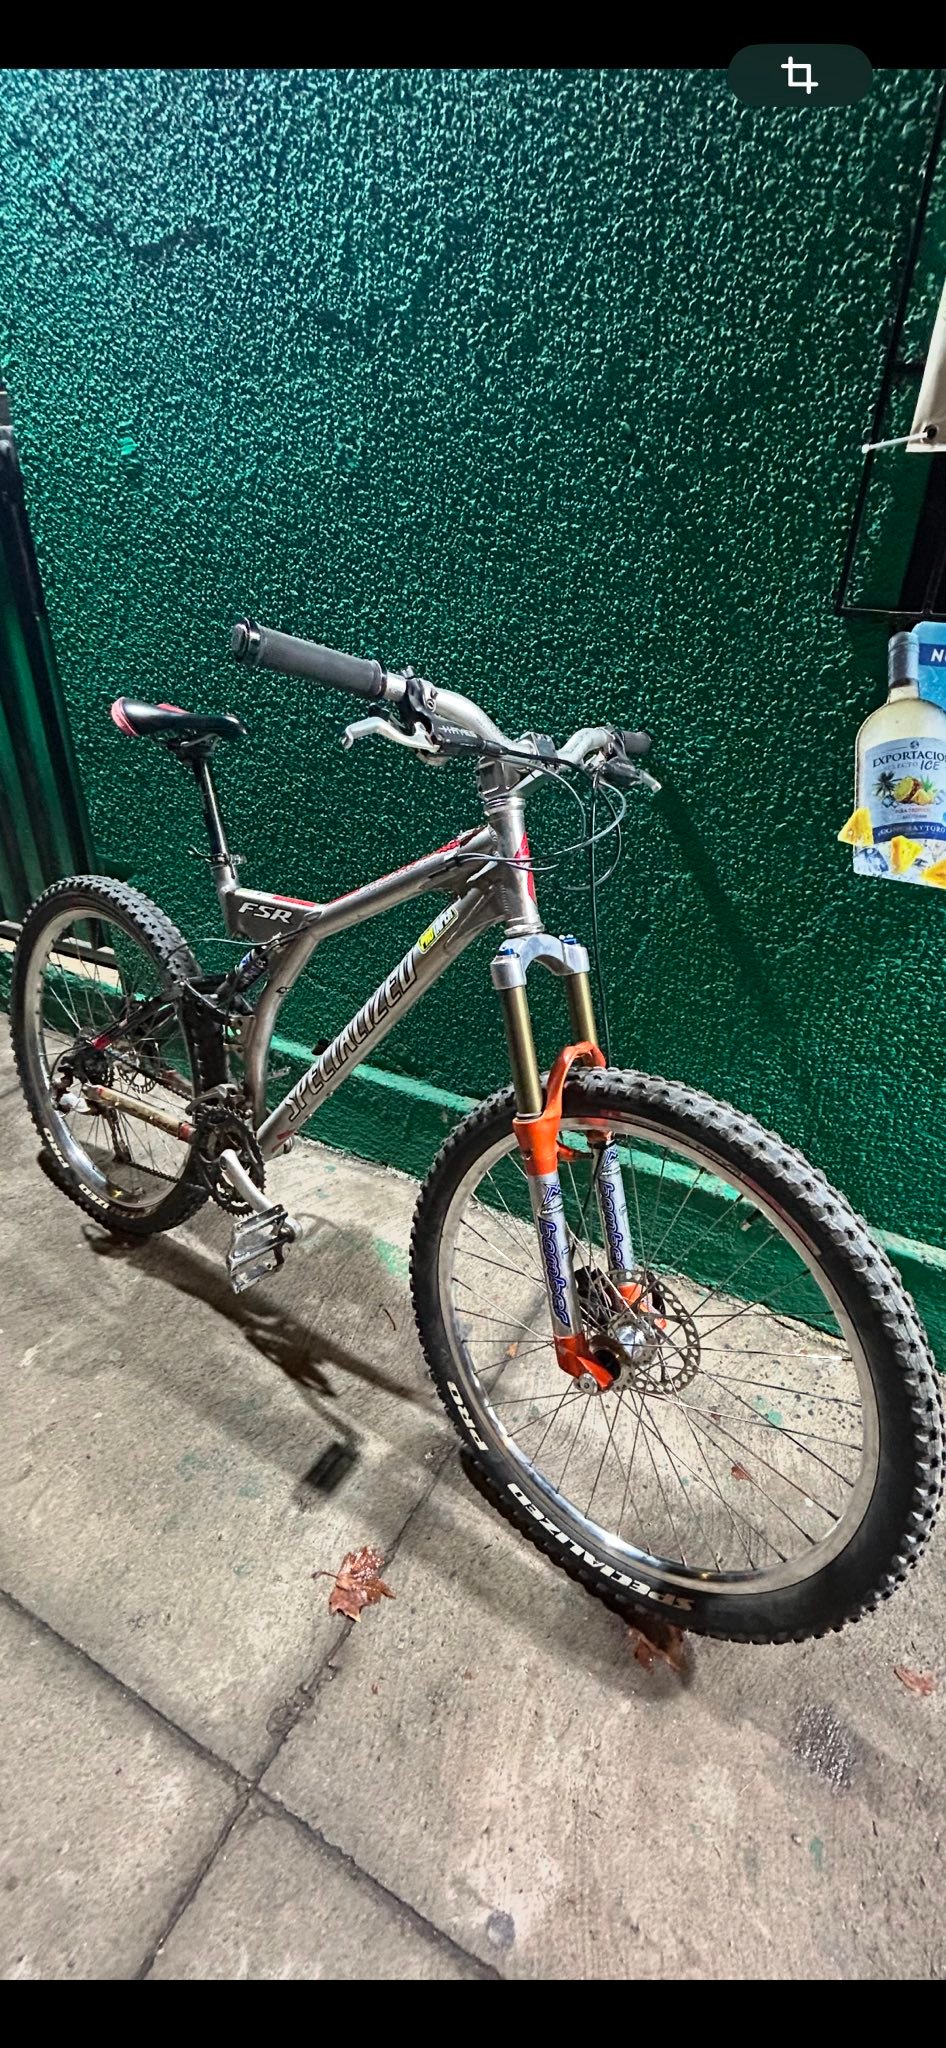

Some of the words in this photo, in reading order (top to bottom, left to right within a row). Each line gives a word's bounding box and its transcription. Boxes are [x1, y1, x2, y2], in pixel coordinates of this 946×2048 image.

[930, 648, 946, 663] N
[873, 750, 946, 768] EXPORTACIO
[920, 760, 941, 771] ICE
[924, 825, 946, 833] TORO
[238, 902, 293, 924] FSR
[43, 1127, 70, 1169] PRO
[537, 1215, 571, 1328] bomber
[447, 1380, 490, 1452] PRO
[507, 1482, 697, 1611] SPECIALIZED
